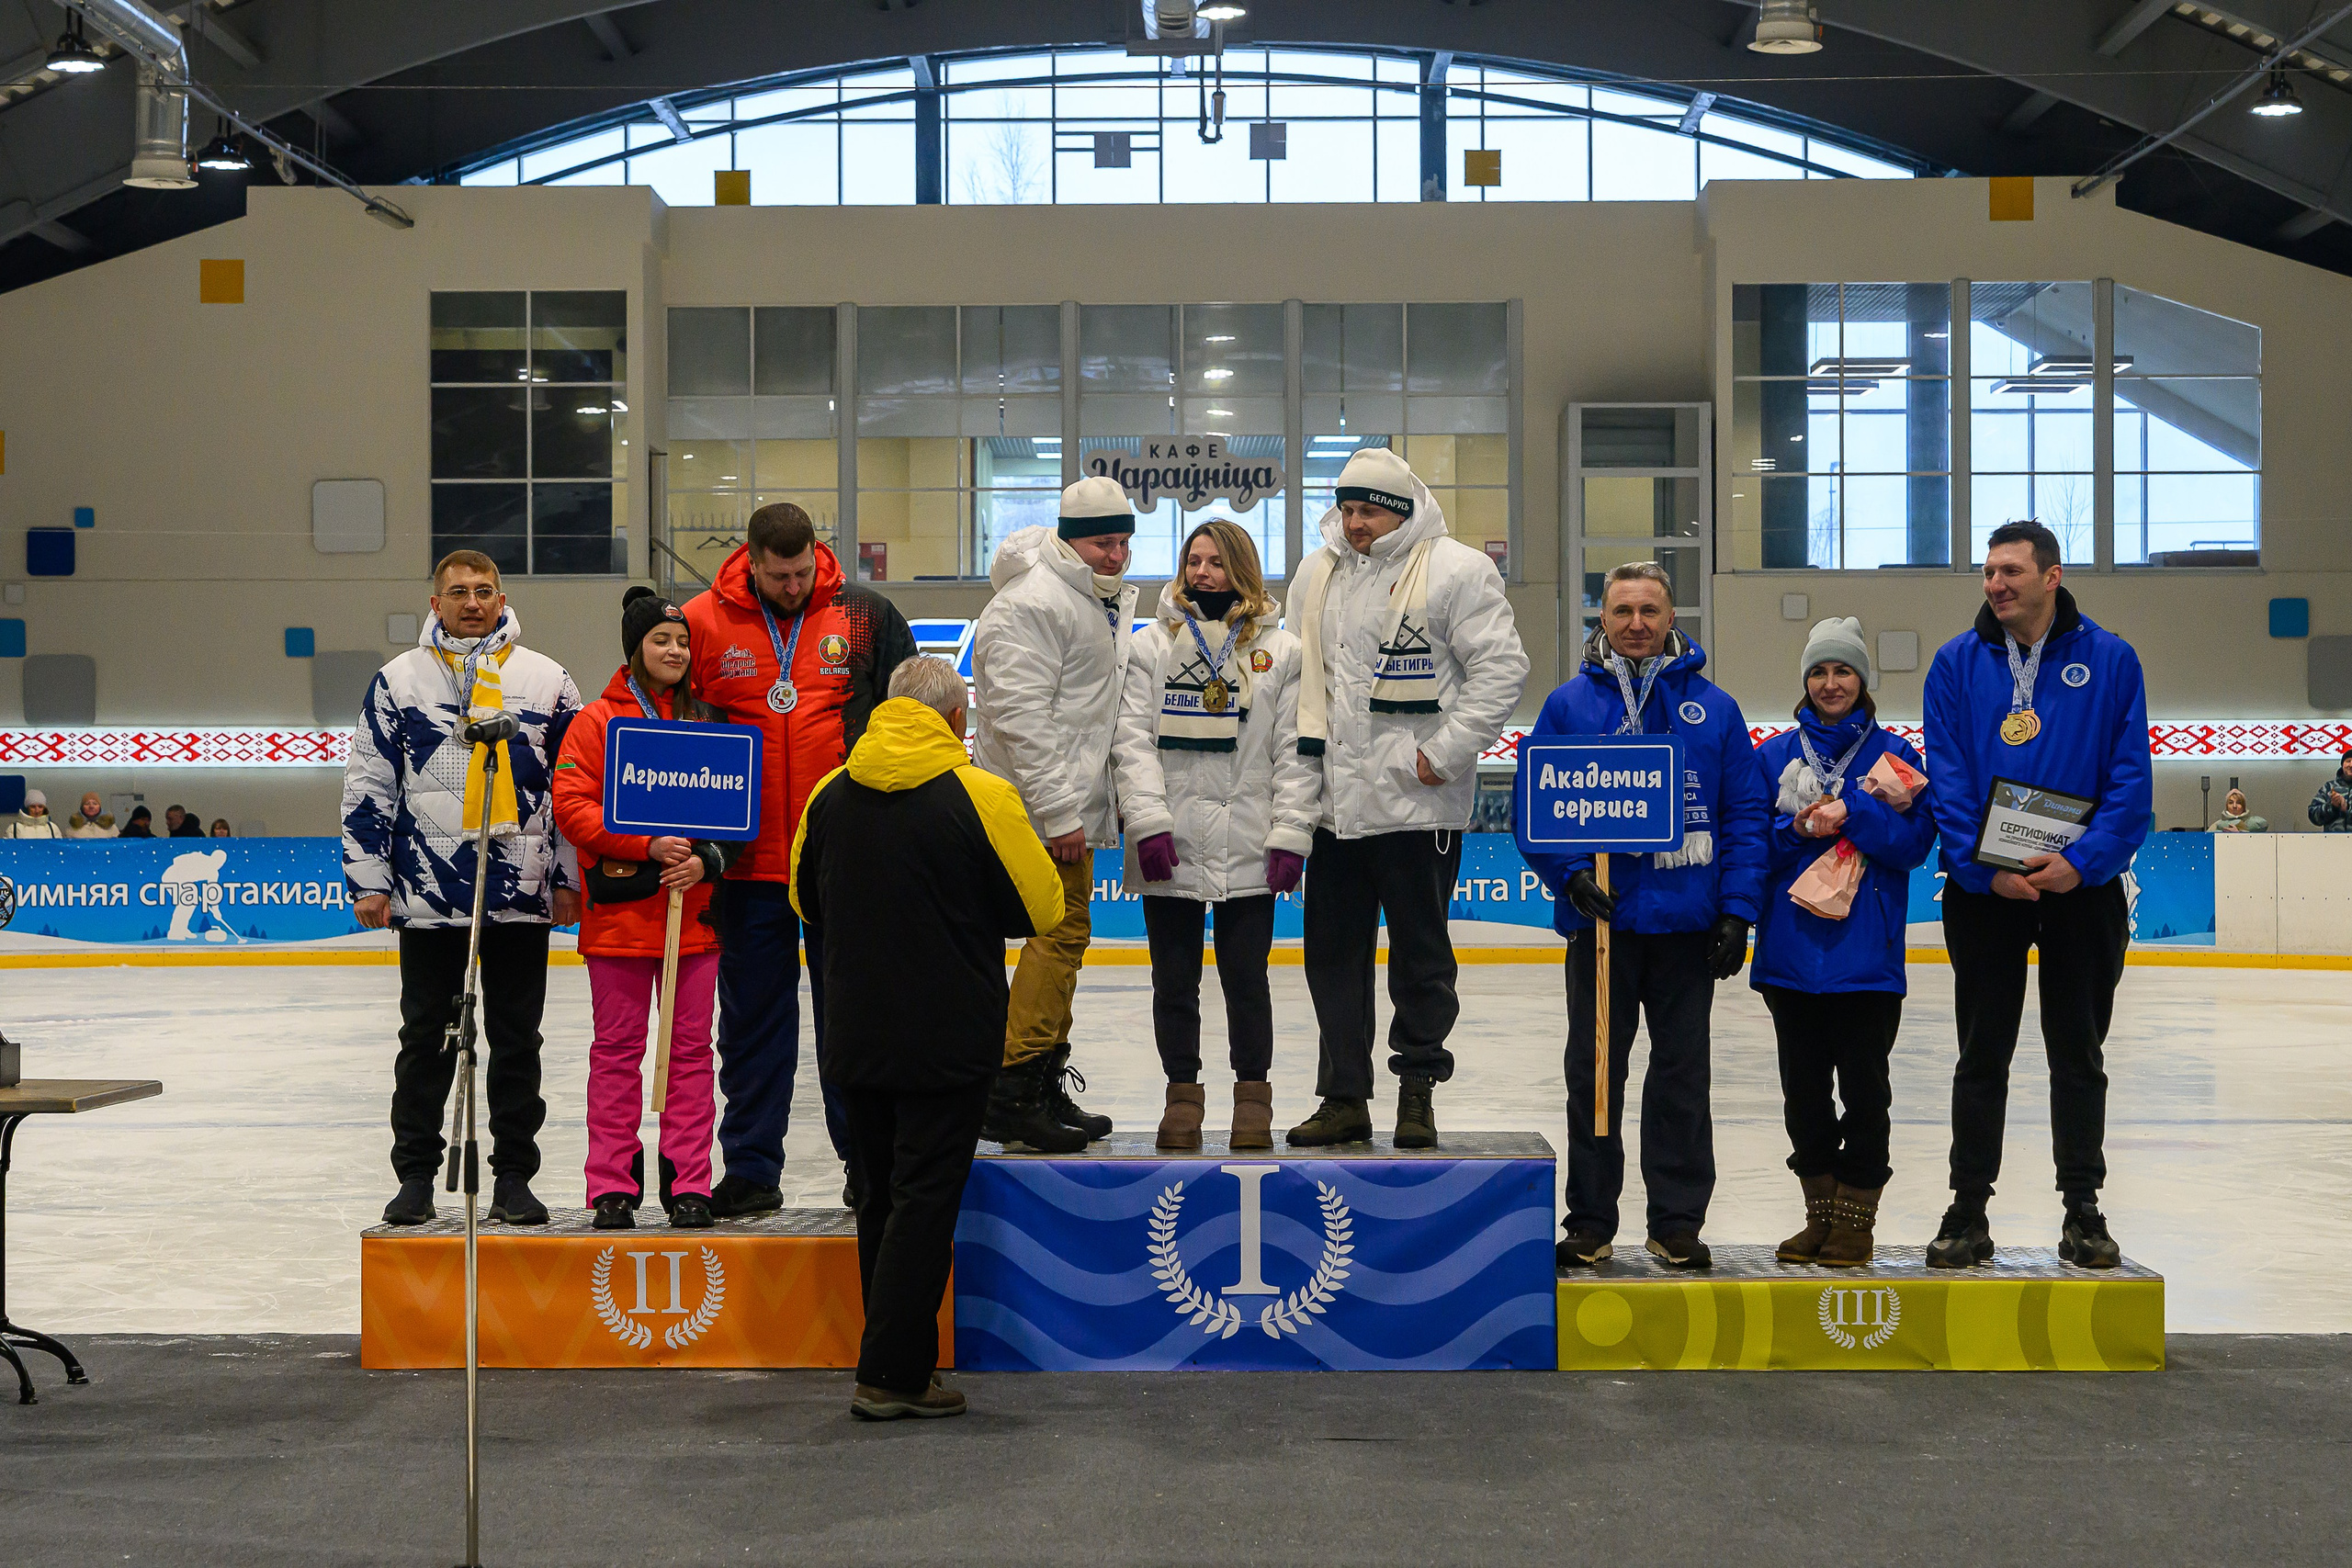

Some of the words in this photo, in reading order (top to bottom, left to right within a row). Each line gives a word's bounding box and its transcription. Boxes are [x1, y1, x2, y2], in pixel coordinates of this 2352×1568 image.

[1149, 444, 1217, 458] КАФЕ
[1091, 457, 1277, 505] Чараўніца
[1369, 492, 1409, 511] БЕЛАРУСЬ
[820, 667, 850, 675] BELARUS
[1164, 693, 1200, 708] БЕЛЫЕ
[621, 762, 744, 792] Агрохолдинг
[1539, 761, 1662, 790] Академия
[1553, 797, 1648, 827] сервиса
[1999, 821, 2071, 846] СЕРТИФИКАТ
[0, 876, 129, 907] имняя
[1453, 878, 1509, 901] нта
[1221, 1164, 1281, 1294] I
[626, 1251, 690, 1314] II
[1831, 1290, 1887, 1325] III
